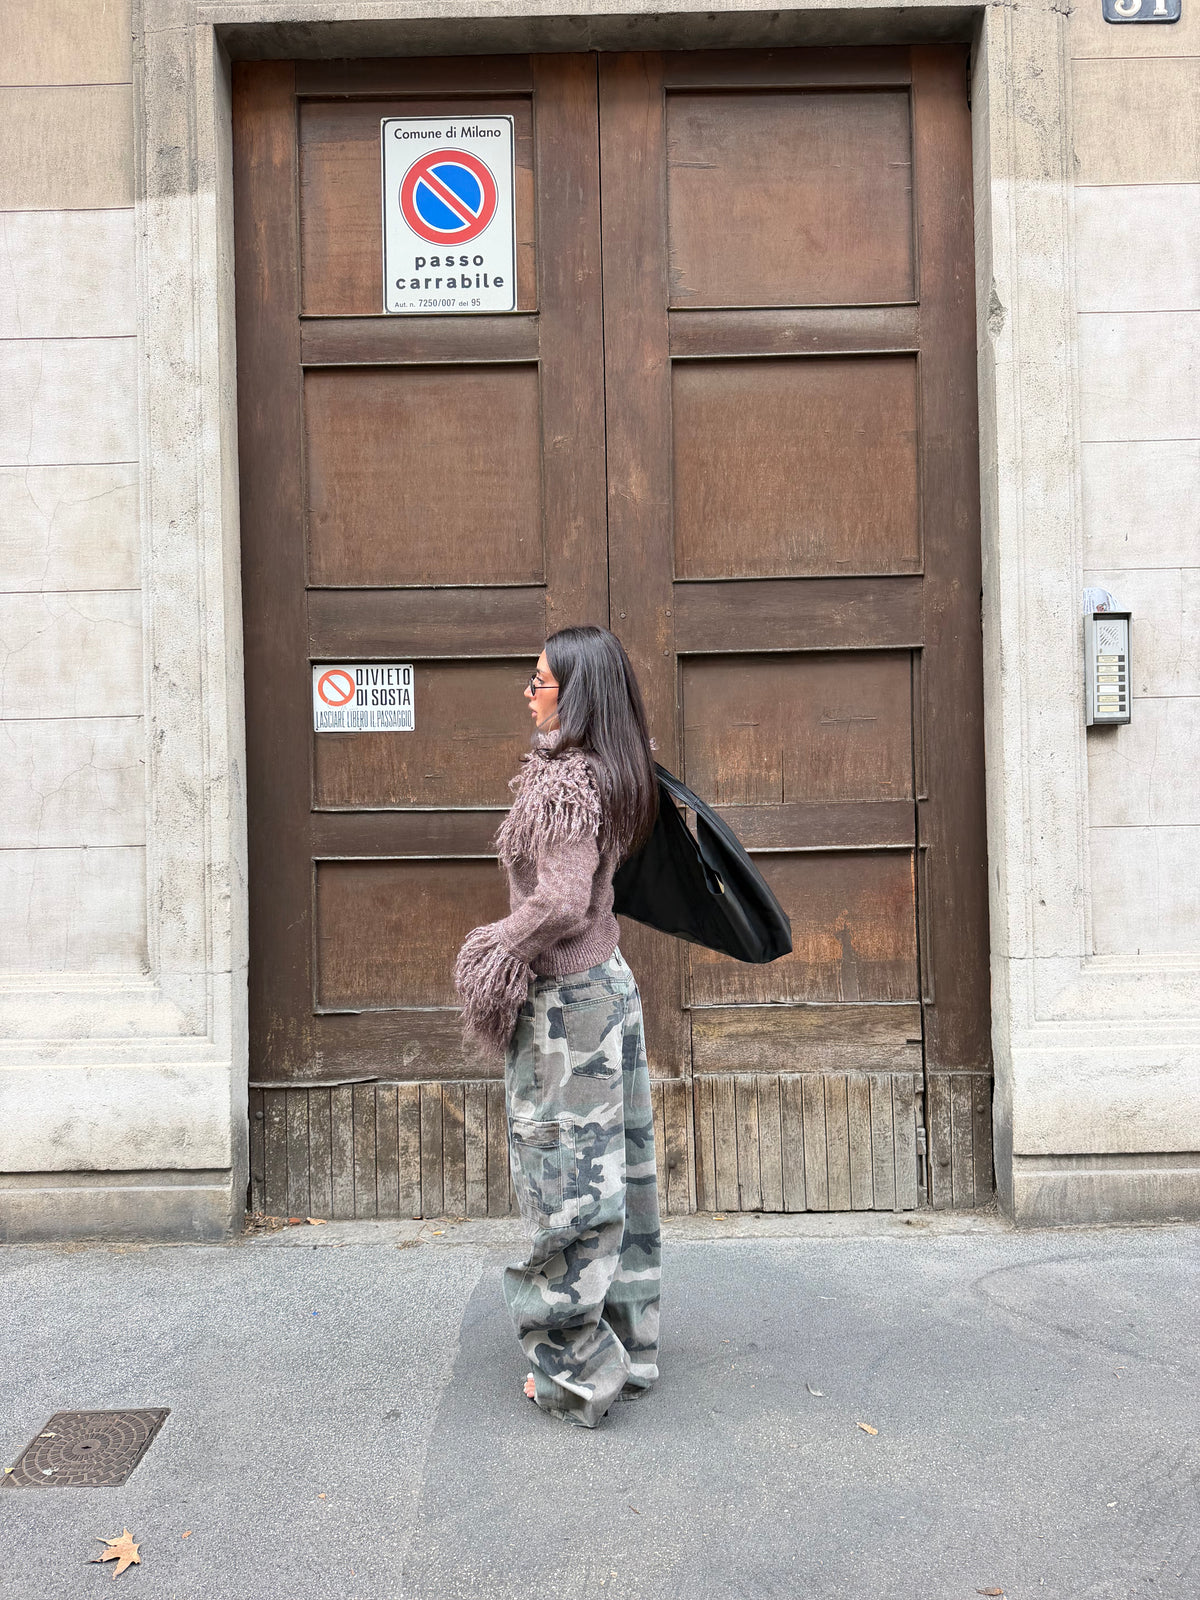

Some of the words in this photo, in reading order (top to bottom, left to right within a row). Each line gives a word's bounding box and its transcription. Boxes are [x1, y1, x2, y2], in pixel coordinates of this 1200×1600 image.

[394, 128, 442, 139] Comune
[445, 126, 457, 138] di
[460, 126, 502, 138] Milano
[415, 255, 484, 270] passo
[395, 273, 504, 290] carrabile
[418, 299, 456, 307] 7250/007
[471, 298, 481, 307] 95
[356, 668, 411, 686] DIVIETO
[356, 689, 368, 706] DI
[371, 688, 411, 706] SOSTA
[315, 711, 345, 728] LASCIARE
[347, 711, 369, 728] LIBERO
[370, 710, 376, 727] IL
[377, 710, 412, 727] PASSAGGIO
